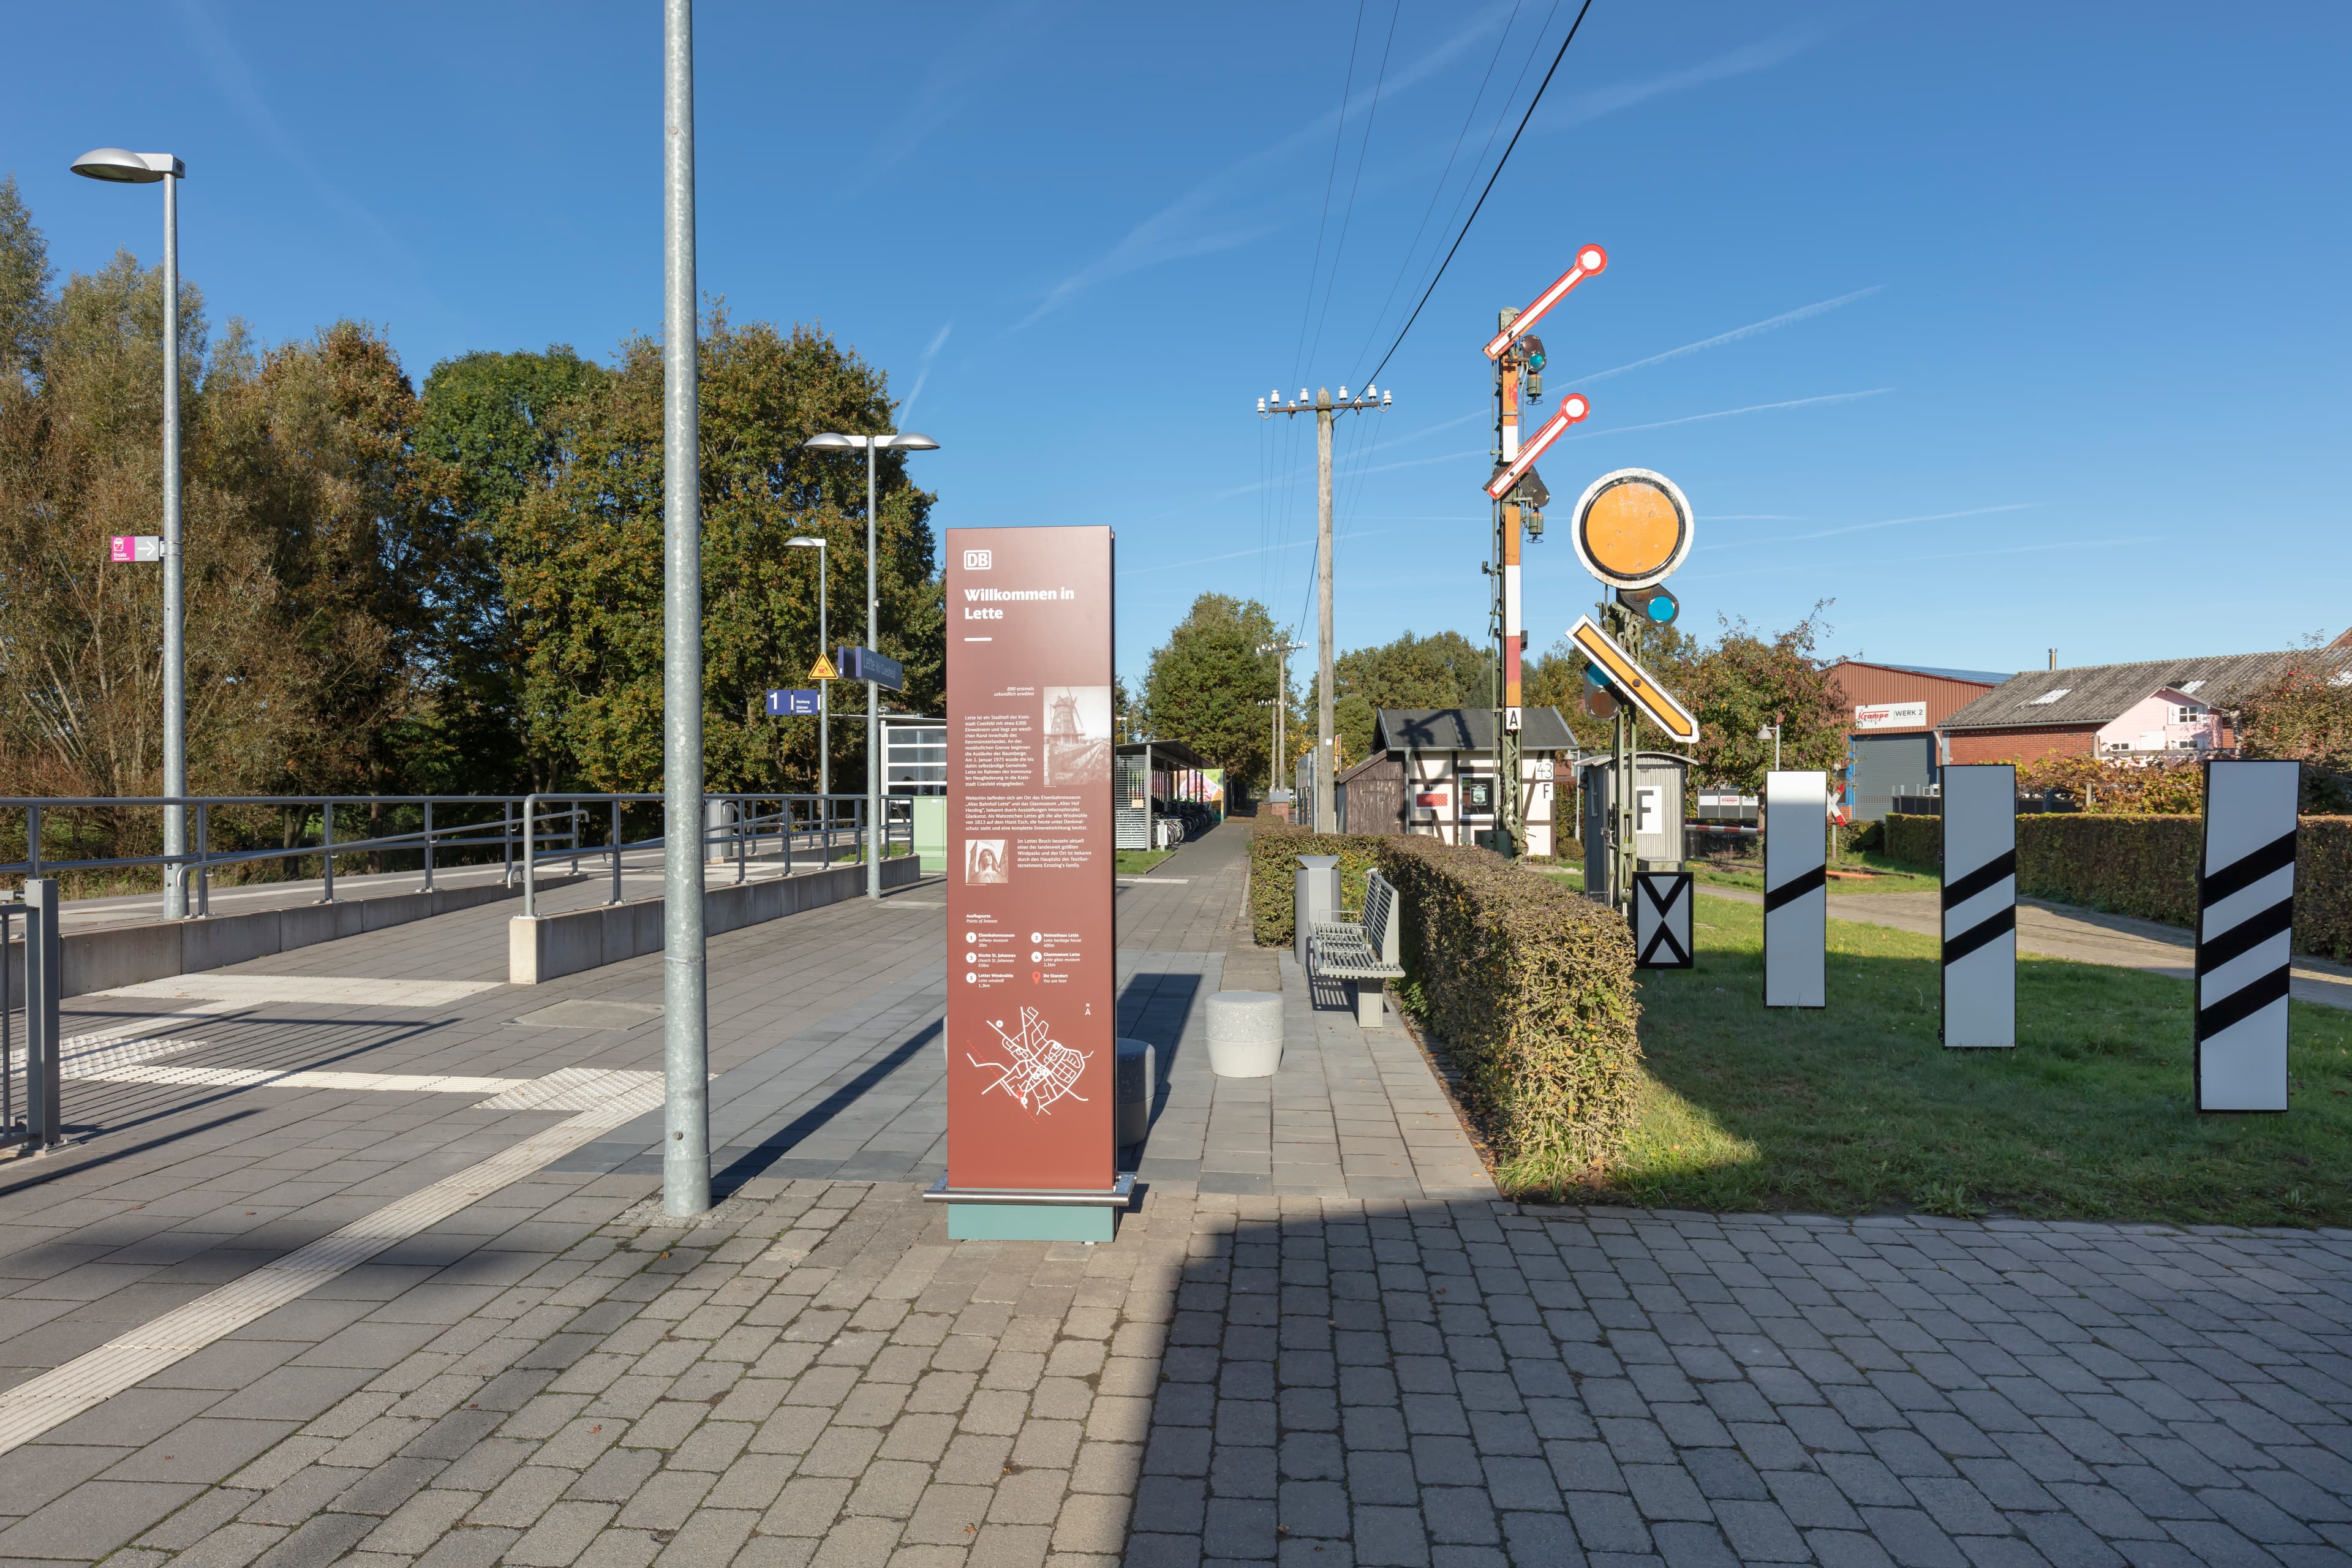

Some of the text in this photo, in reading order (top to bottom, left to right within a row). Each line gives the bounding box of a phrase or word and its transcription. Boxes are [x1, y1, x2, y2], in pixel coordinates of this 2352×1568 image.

[967, 553, 988, 567] DB
[964, 586, 1074, 601] Willkommen in
[965, 607, 1003, 619] Lette
[864, 652, 875, 671] Lette
[770, 692, 777, 710] 1
[1509, 710, 1518, 726] A
[1858, 710, 1890, 722] Krampe
[1537, 763, 1552, 779] 43
[1543, 784, 1550, 799] F
[1636, 790, 1654, 830] F
